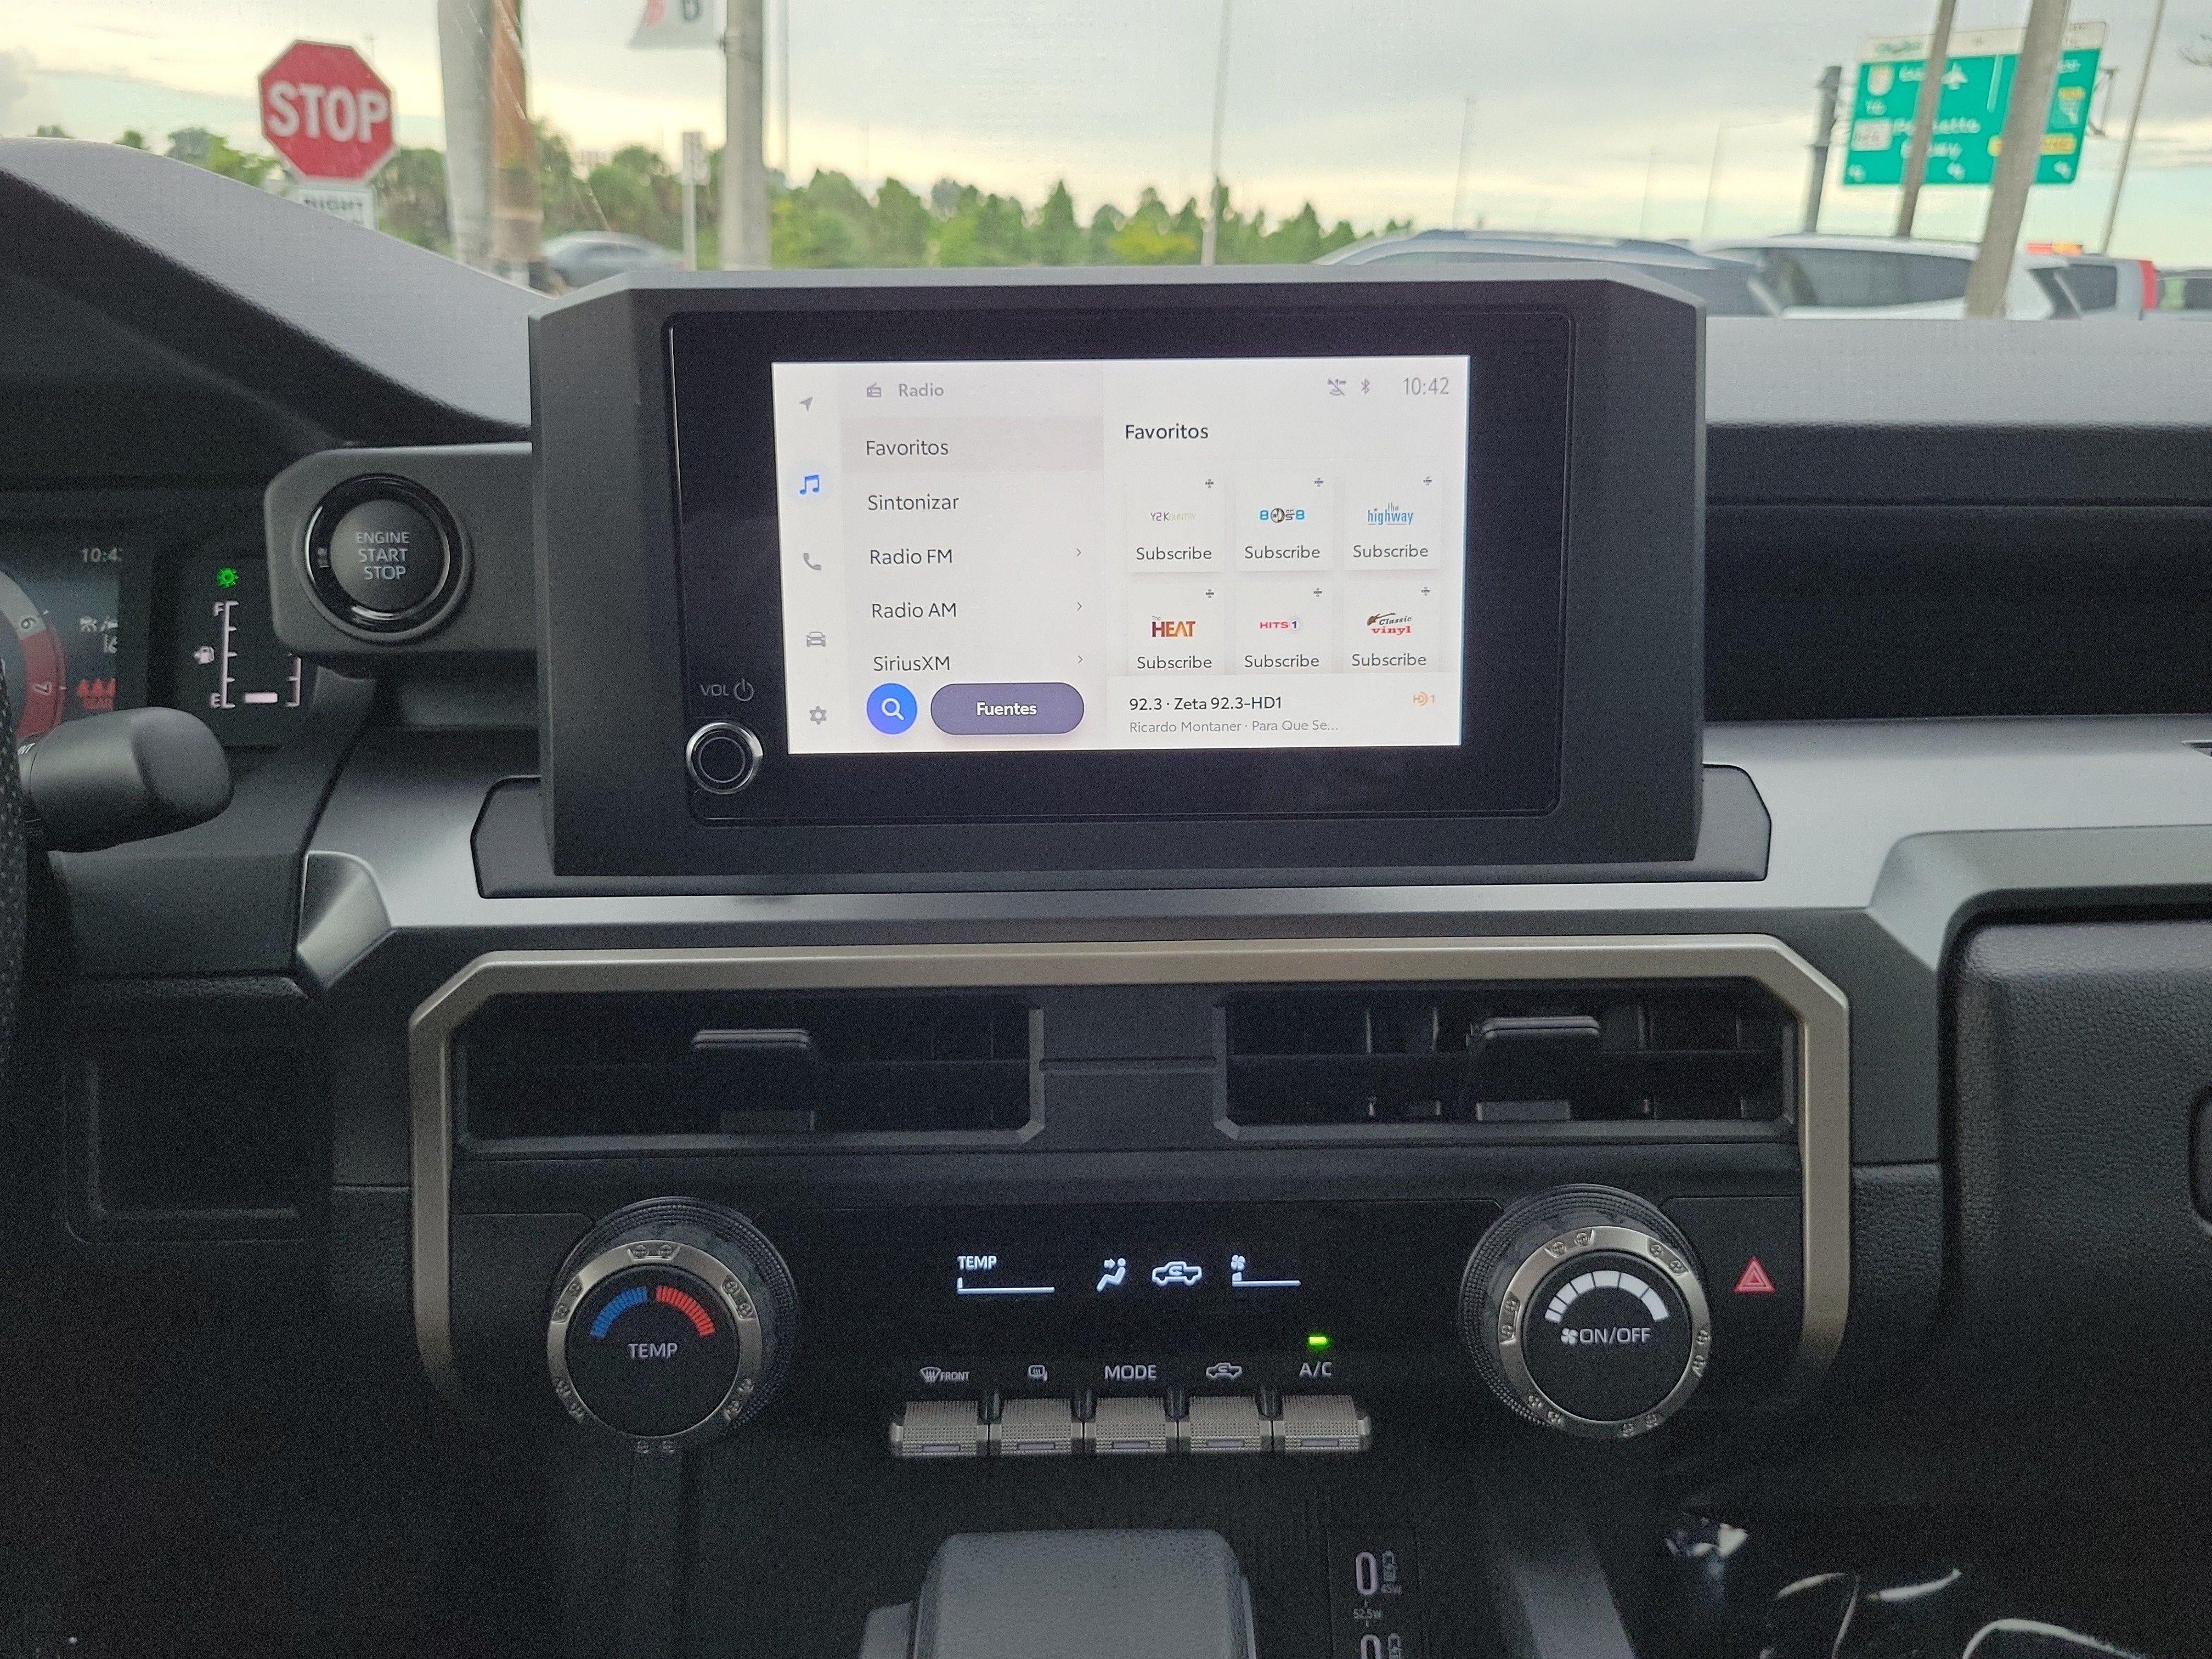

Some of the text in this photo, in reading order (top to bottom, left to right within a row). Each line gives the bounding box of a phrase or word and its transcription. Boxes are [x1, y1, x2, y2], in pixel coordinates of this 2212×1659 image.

[268, 81, 388, 143] STOP
[899, 382, 944, 397] Radio
[1403, 377, 1449, 396] 10:42
[1125, 423, 1209, 440] Favoritos
[866, 439, 949, 456] Favoritos
[868, 494, 960, 511] Sintonizar
[1368, 508, 1413, 525] highway
[357, 532, 409, 544] ENGINE
[82, 548, 123, 562] 10:4
[358, 548, 408, 562] START
[870, 548, 953, 565] Radio FM
[1136, 546, 1212, 560] Subscribe
[1244, 545, 1321, 559] Subscribe
[1353, 544, 1429, 558] Subscribe
[364, 565, 406, 580] STOP
[213, 602, 224, 617] F
[872, 602, 957, 618] Radio AM
[1379, 616, 1412, 625] Classic
[1152, 621, 1195, 637] HEAT
[1371, 626, 1411, 635] vinyl
[873, 656, 951, 672] SiriusXM
[1137, 655, 1212, 669] Subscribe
[1244, 653, 1319, 668] Subscribe
[1351, 652, 1427, 667] Subscribe
[700, 684, 730, 696] VOL
[209, 693, 221, 708] E
[1129, 696, 1282, 711] 92.3 Zeta 92.3-HD1
[976, 701, 1037, 716] Fuentes
[1130, 721, 1177, 733] Ricardo
[1181, 721, 1242, 732] Montaner
[1252, 720, 1278, 731] Para
[1282, 720, 1308, 731] Que
[957, 1255, 997, 1271] TEMP
[1579, 1327, 1651, 1344] ON/OFF
[628, 1342, 678, 1358] TEMP
[940, 1372, 970, 1381] FRONT
[1104, 1364, 1157, 1380] MODE
[1299, 1362, 1333, 1379] A/C
[1353, 1609, 1382, 1619] 52.5W
